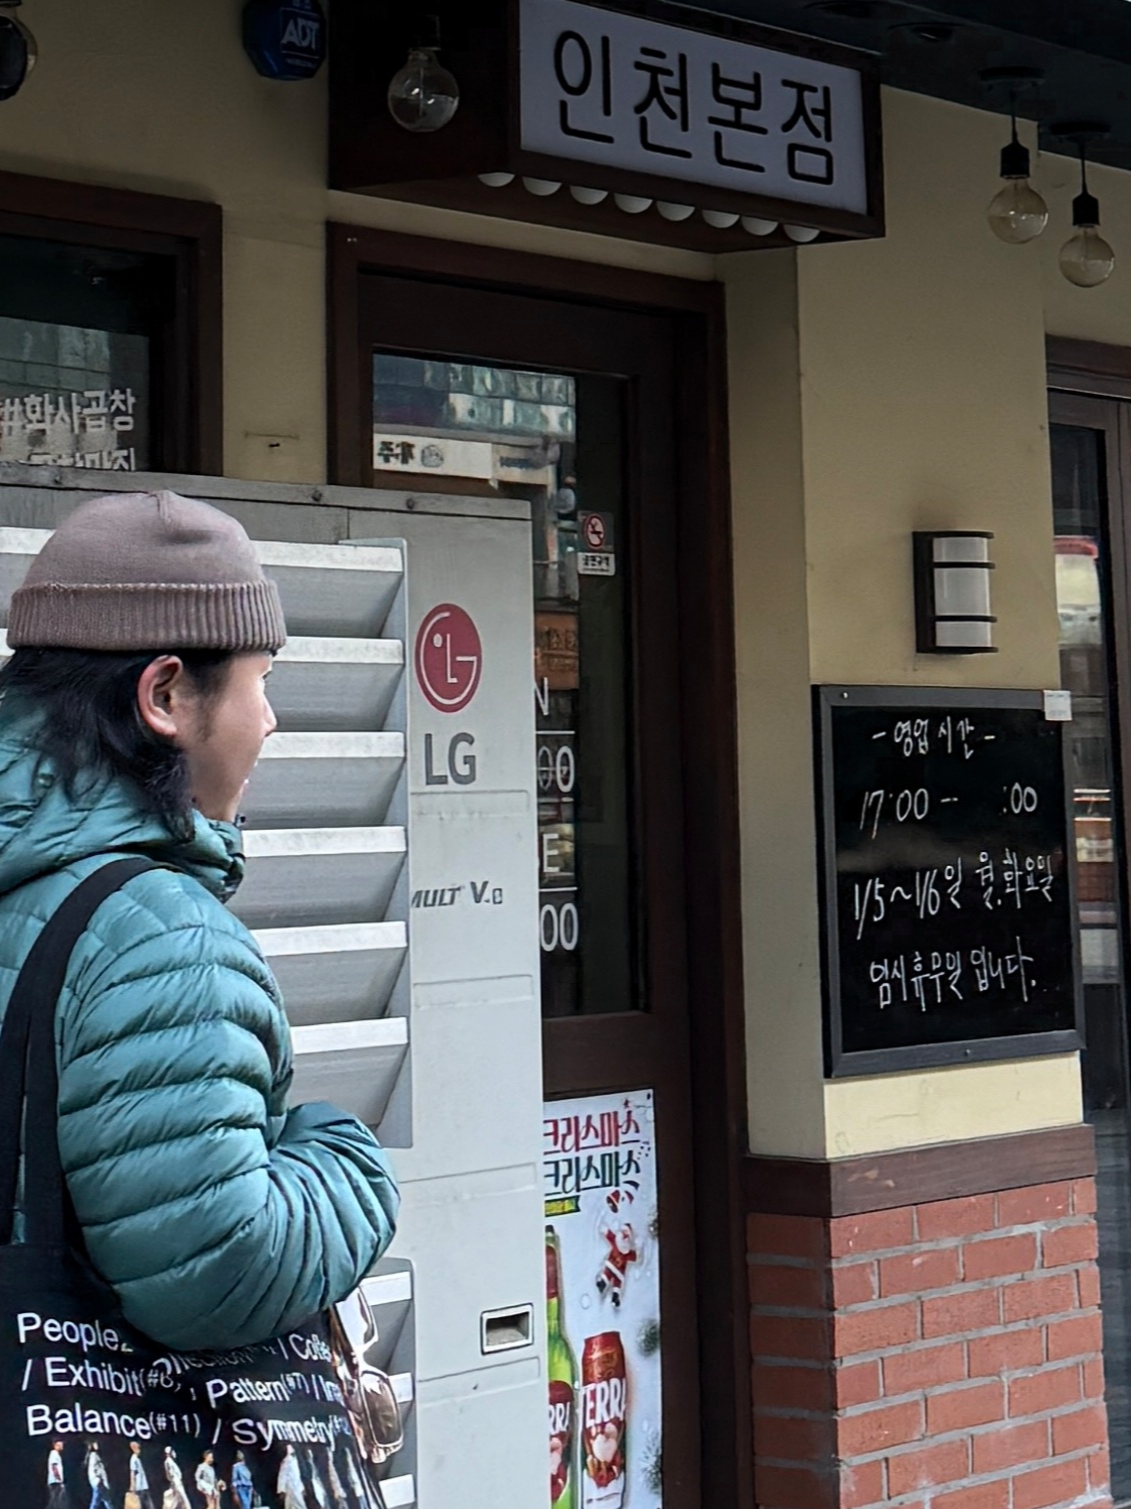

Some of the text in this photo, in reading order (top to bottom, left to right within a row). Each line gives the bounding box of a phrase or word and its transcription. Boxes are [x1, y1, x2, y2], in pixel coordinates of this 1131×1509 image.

[280, 17, 319, 51] ADT
[552, 28, 835, 187] 인천본점
[424, 731, 477, 786] LG
[543, 1109, 640, 1156] 크리스마스
[543, 1149, 641, 1197] 크리스마스
[17, 1312, 119, 1353] People
